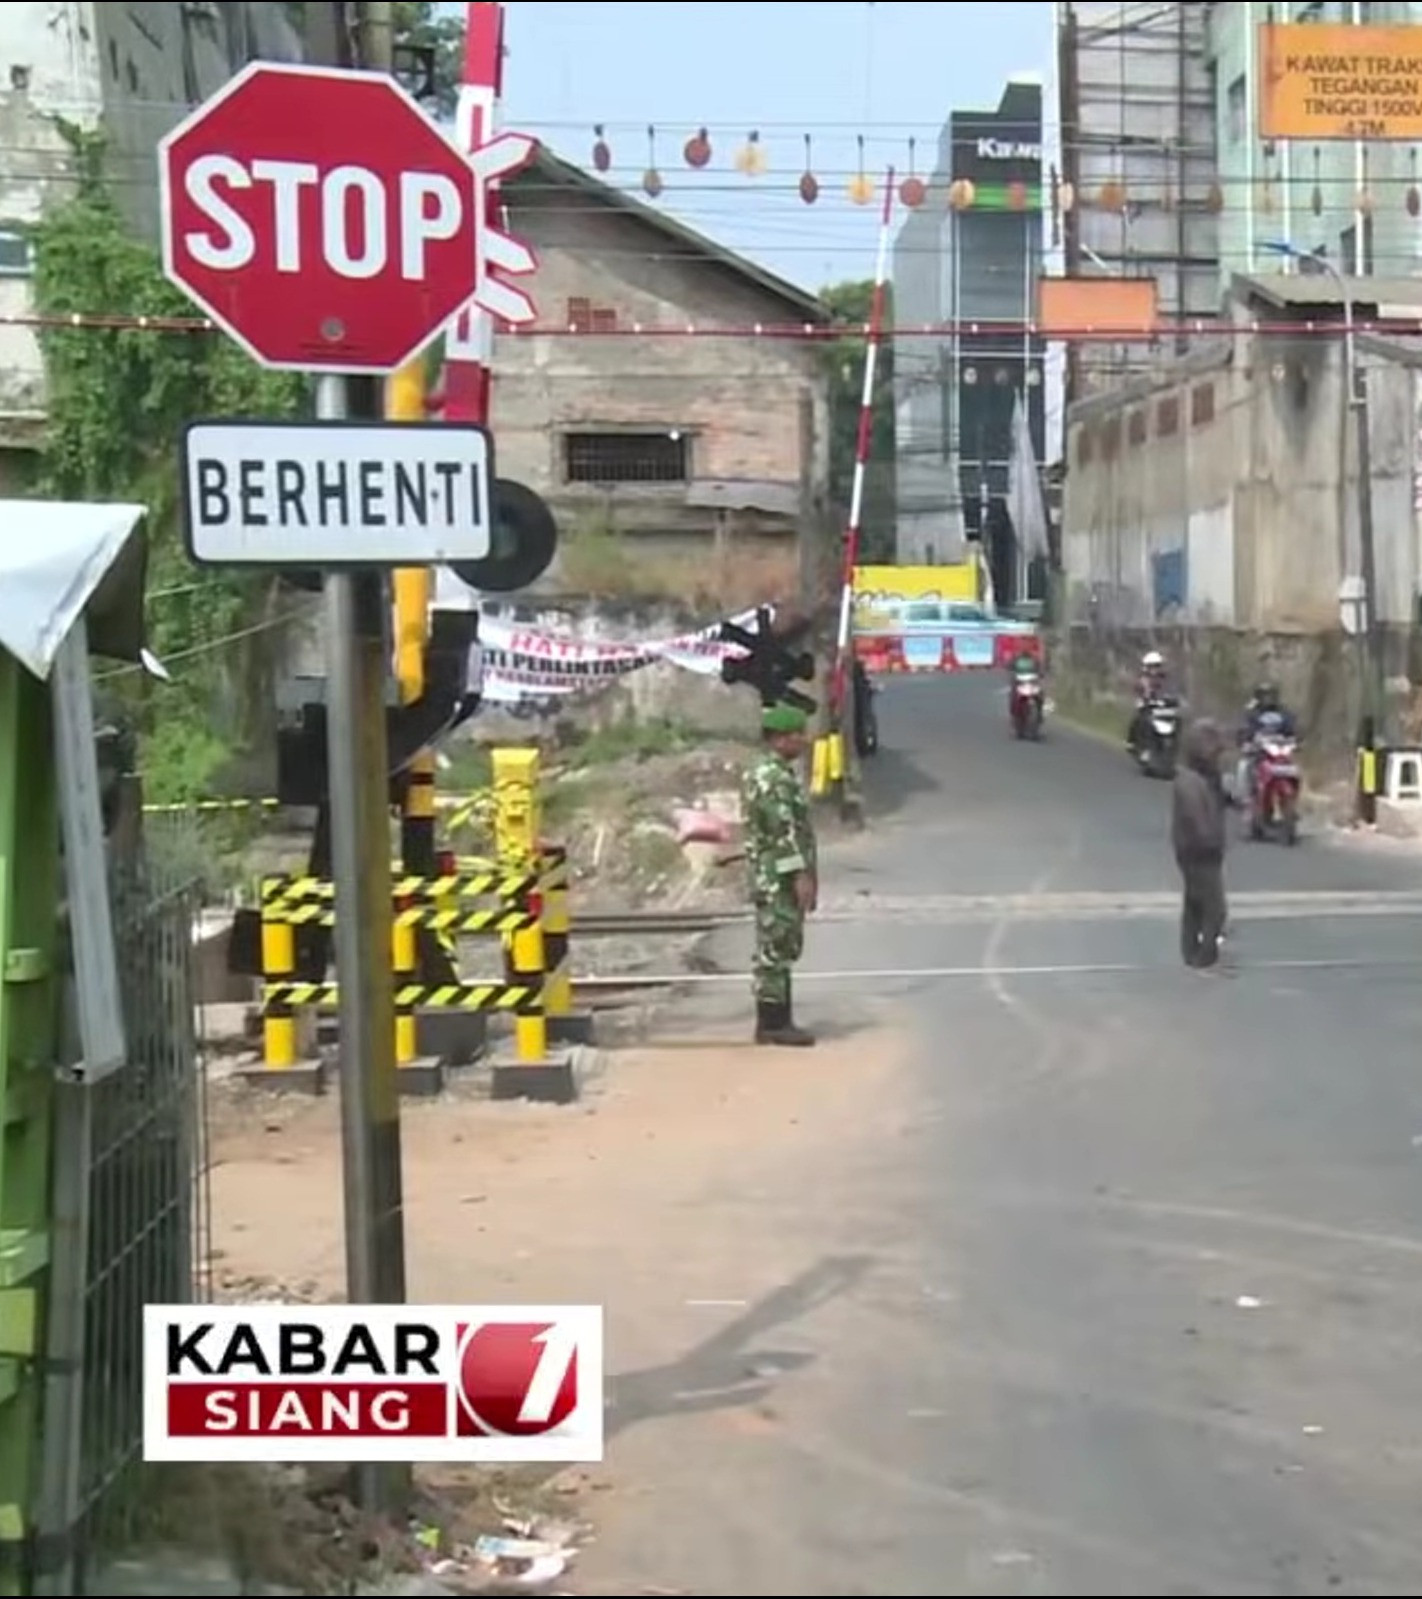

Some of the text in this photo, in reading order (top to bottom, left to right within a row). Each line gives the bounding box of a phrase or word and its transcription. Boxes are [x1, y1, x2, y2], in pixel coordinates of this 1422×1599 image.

[1286, 55, 1359, 74] KAWAT
[1309, 77, 1420, 96] TEGANGAN
[1303, 99, 1368, 116] TINGGI
[184, 153, 463, 281] STOP
[197, 457, 482, 527] BERHENTI
[512, 651, 664, 676] PERLINTASA
